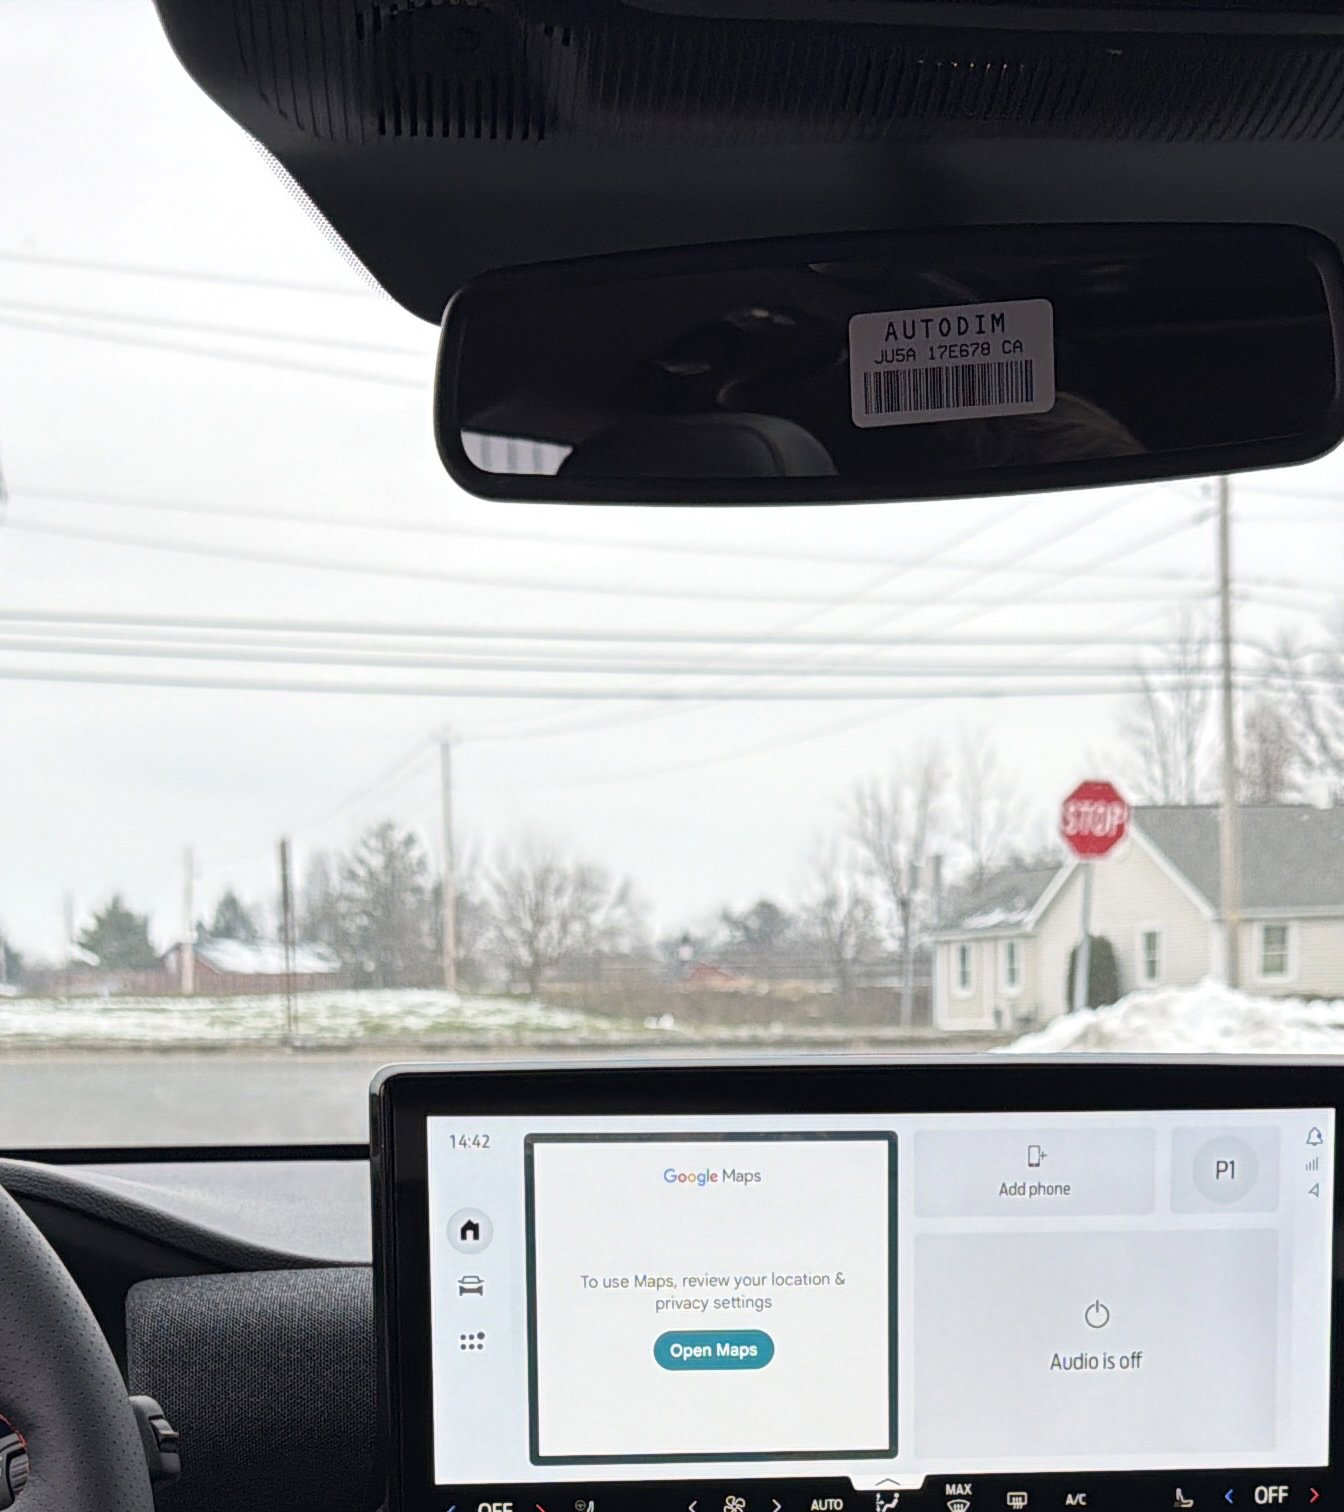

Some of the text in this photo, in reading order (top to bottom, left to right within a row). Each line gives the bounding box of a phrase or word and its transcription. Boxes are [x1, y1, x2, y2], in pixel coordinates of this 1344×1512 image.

[885, 313, 1006, 342] AUTODIM
[874, 340, 1023, 364] JU5A 17E678 CA
[1063, 800, 1128, 836] STOP
[449, 1134, 490, 1150] 14:42
[663, 1168, 761, 1188] Google Maps
[1215, 1160, 1235, 1180] P1
[999, 1182, 1071, 1198] Add phone
[580, 1271, 846, 1293] To use Maps, review your location &
[655, 1294, 772, 1314] privacy settings
[669, 1342, 758, 1361] Open Maps
[1050, 1352, 1143, 1371] Audio is off
[945, 1484, 972, 1496] MAX
[1065, 1492, 1087, 1506] A/C
[1255, 1486, 1289, 1504] OFF
[810, 1498, 844, 1512] AUTO
